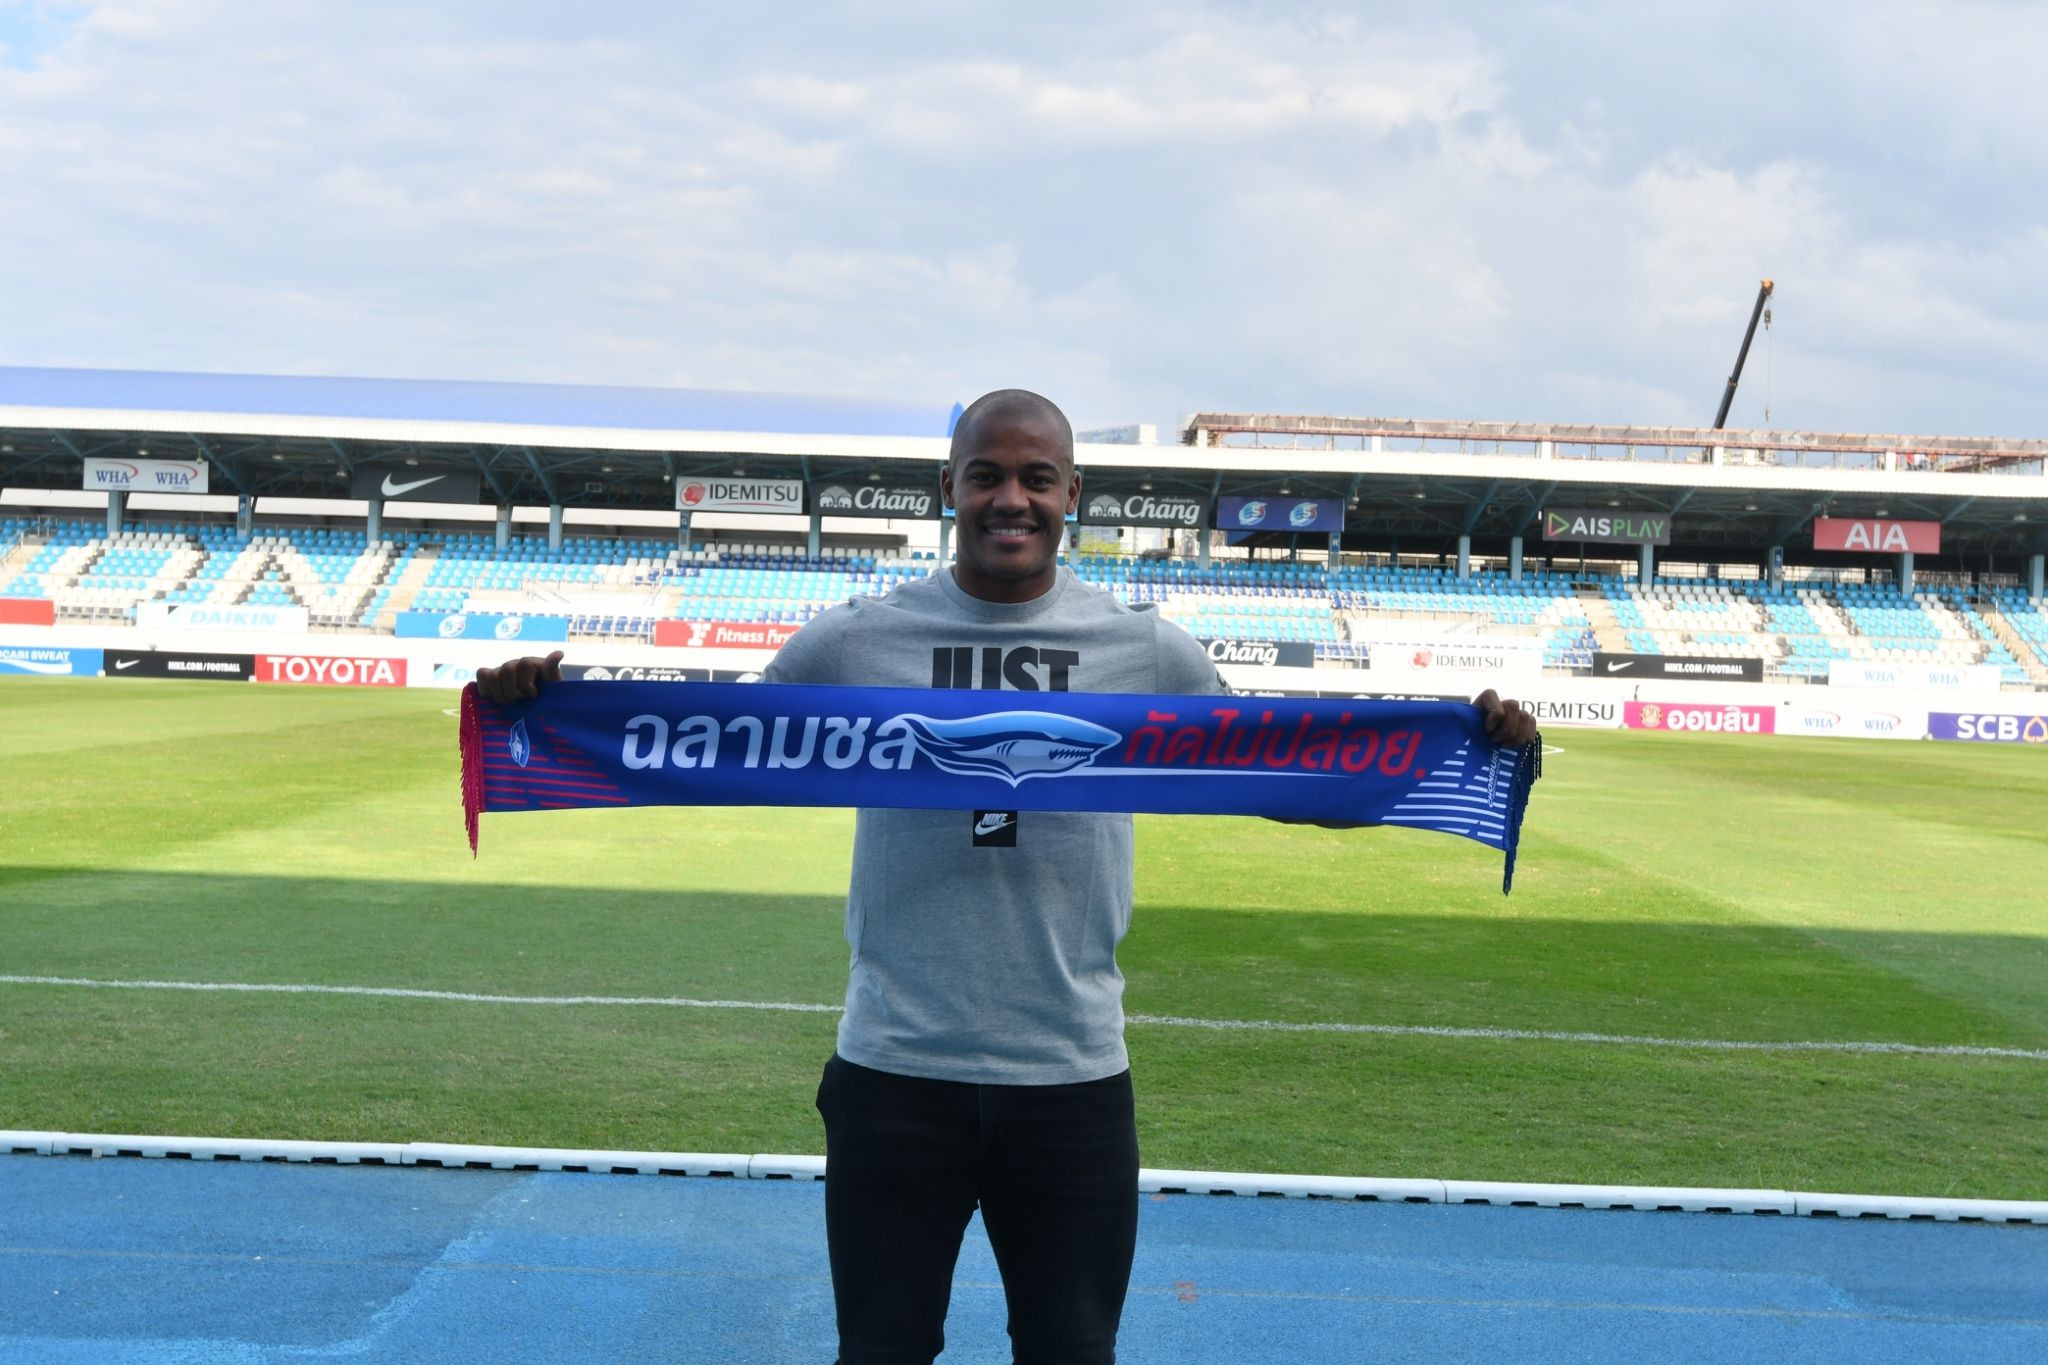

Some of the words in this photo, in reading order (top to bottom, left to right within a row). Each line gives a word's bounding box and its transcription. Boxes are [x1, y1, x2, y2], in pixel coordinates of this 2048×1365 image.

[96, 470, 130, 484] WHA
[155, 472, 190, 485] WHA
[709, 483, 798, 502] IDEMITSU
[855, 486, 931, 516] Chang
[1124, 495, 1200, 525] Chang
[1844, 522, 1909, 551] AIA
[189, 610, 277, 626] DAIKIN
[31, 650, 71, 661] SWEAT
[1207, 639, 1279, 666] Chang
[167, 661, 241, 673] NIKE.COM/FOOTBALL
[266, 656, 396, 684] TOYOTA
[1436, 655, 1504, 669] IDEMITSU
[1664, 662, 1744, 675] NIKE.COM/FOOTBALL
[1864, 671, 1896, 682] WHA
[1928, 673, 1960, 684] WHA
[1667, 705, 1761, 733] ออมสิน
[1804, 717, 1833, 729] WHA
[1864, 719, 1894, 731] WHA
[1957, 714, 2020, 740] SCB
[621, 713, 917, 771] ฉลามชล
[981, 813, 1009, 826] NIKE
